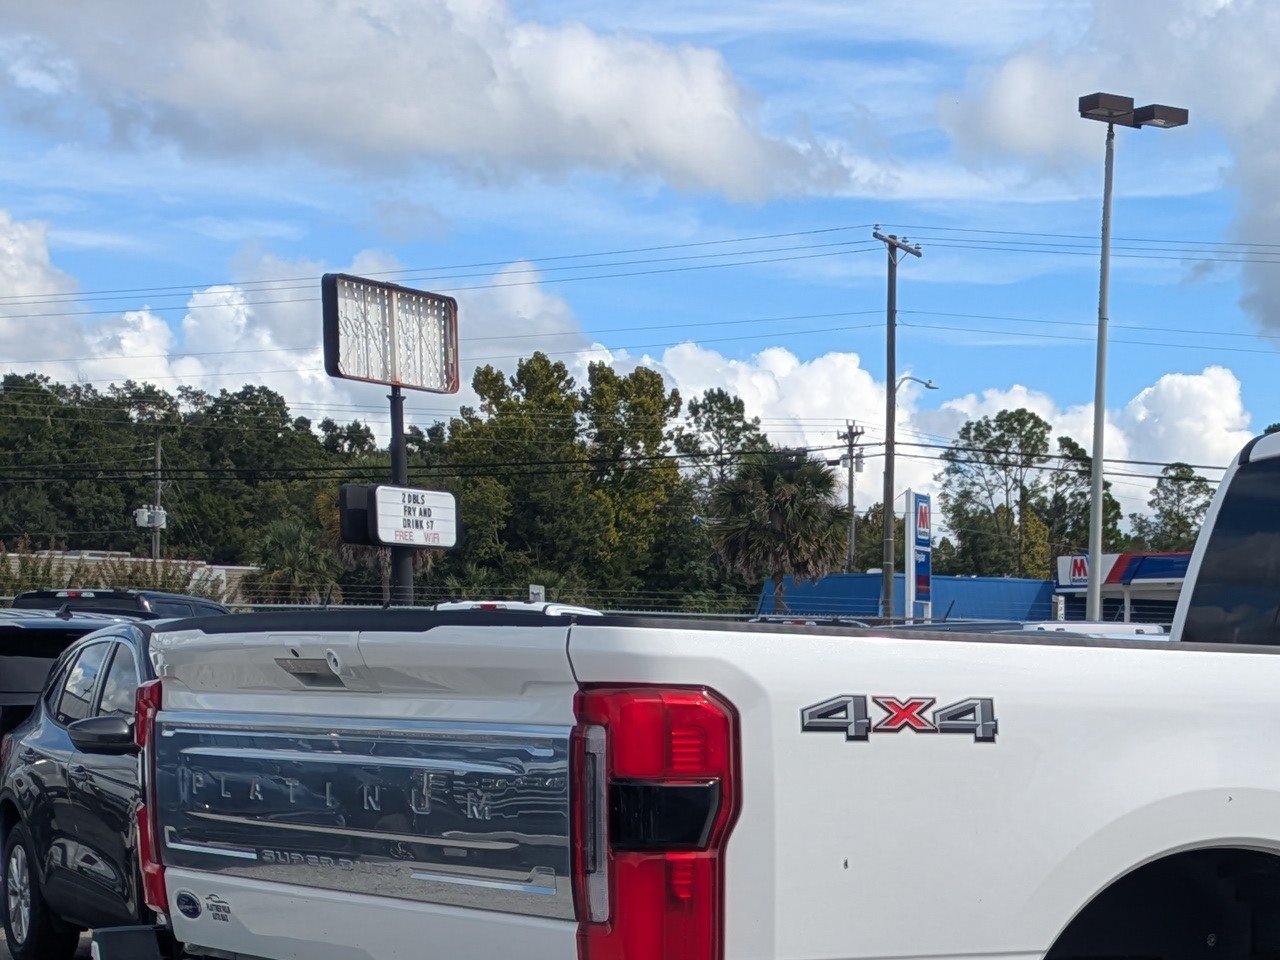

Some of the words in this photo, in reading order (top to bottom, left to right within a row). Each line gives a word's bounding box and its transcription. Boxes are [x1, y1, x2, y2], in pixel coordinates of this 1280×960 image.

[402, 493, 406, 503] 2
[408, 493, 425, 505] DBLS
[403, 505, 417, 517] FRY
[419, 507, 432, 518] AND
[403, 518, 424, 530] DRINK
[426, 520, 434, 530] $7
[395, 530, 414, 541] FREE
[1072, 558, 1088, 577] M
[192, 772, 492, 820] PLATINUM
[262, 849, 335, 868] SUPER
[339, 858, 401, 877] DUTY
